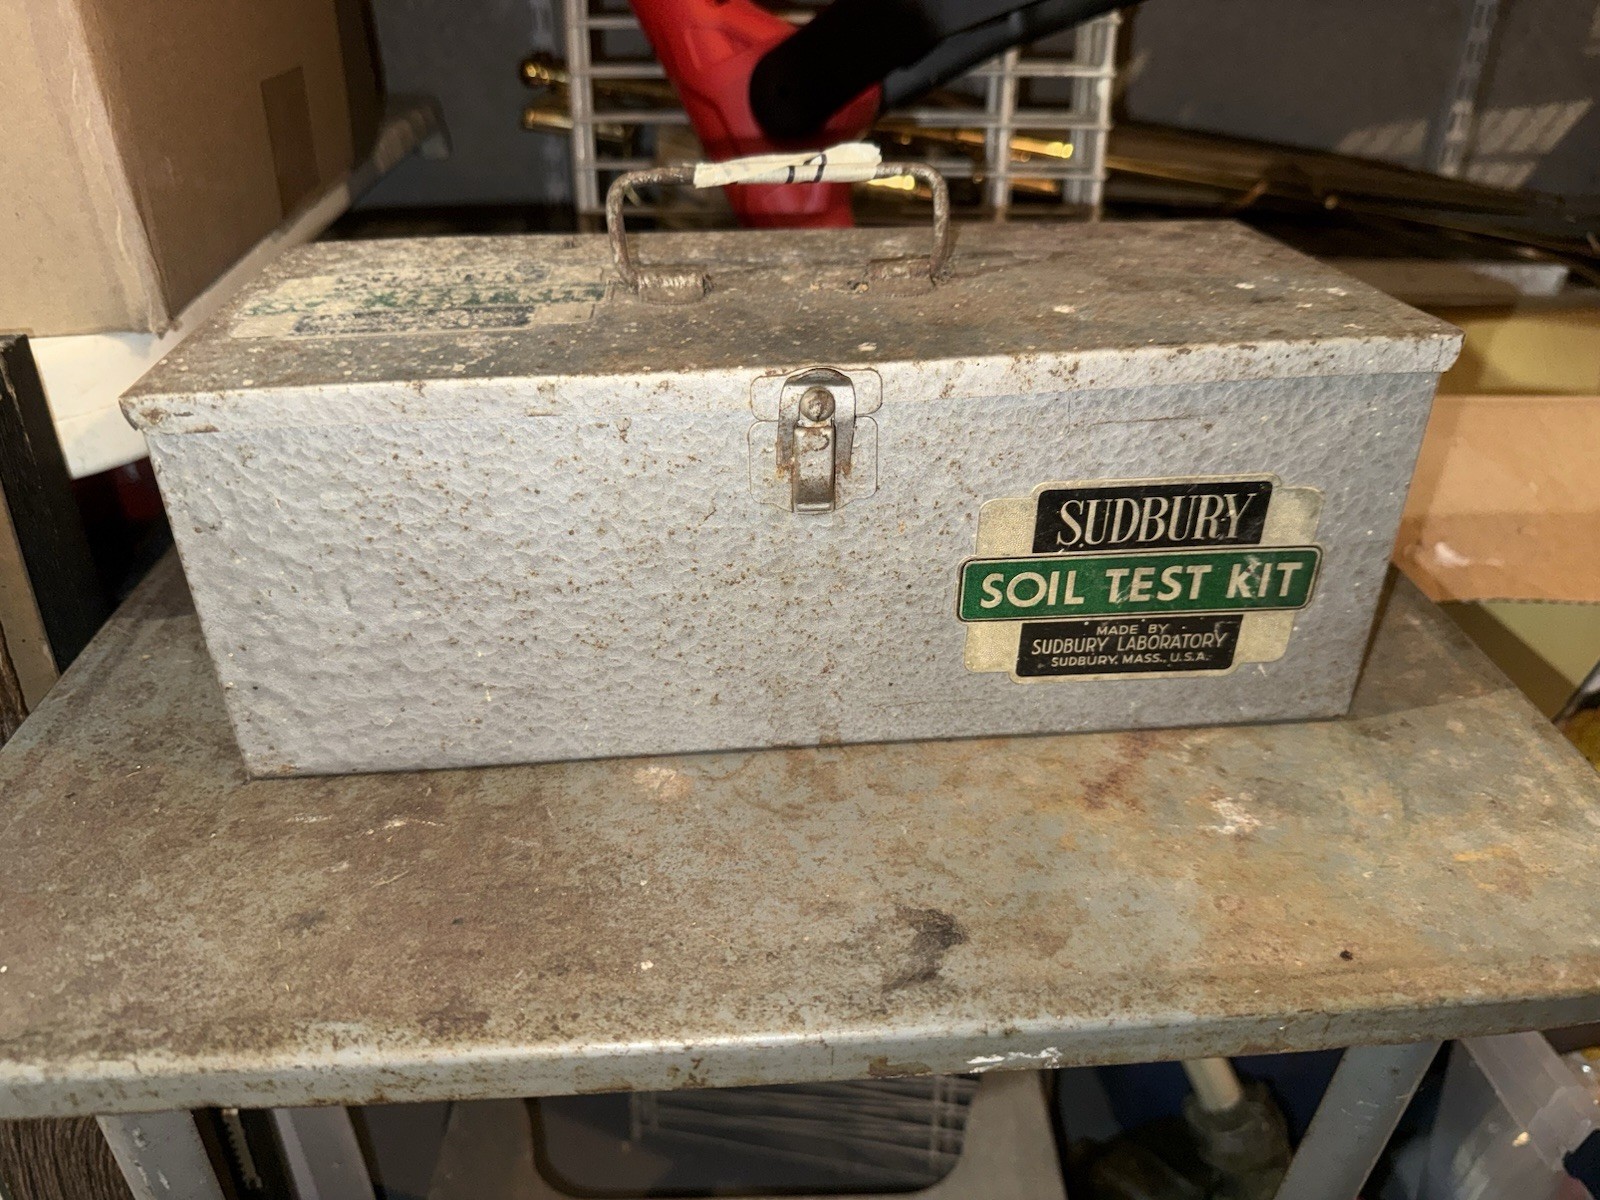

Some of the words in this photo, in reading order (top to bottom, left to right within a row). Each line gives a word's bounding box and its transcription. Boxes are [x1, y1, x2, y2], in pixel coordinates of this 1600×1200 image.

[1056, 493, 1257, 548] SUDBURY
[979, 570, 1085, 609] SOIL
[1105, 564, 1212, 604] TEST
[1226, 561, 1304, 599] KIT
[1096, 624, 1138, 636] MADE
[1148, 623, 1169, 635] BY
[1031, 636, 1110, 655] SUDBURY
[1117, 632, 1228, 652] LABORATORY
[1169, 651, 1209, 662] U.S.A.
